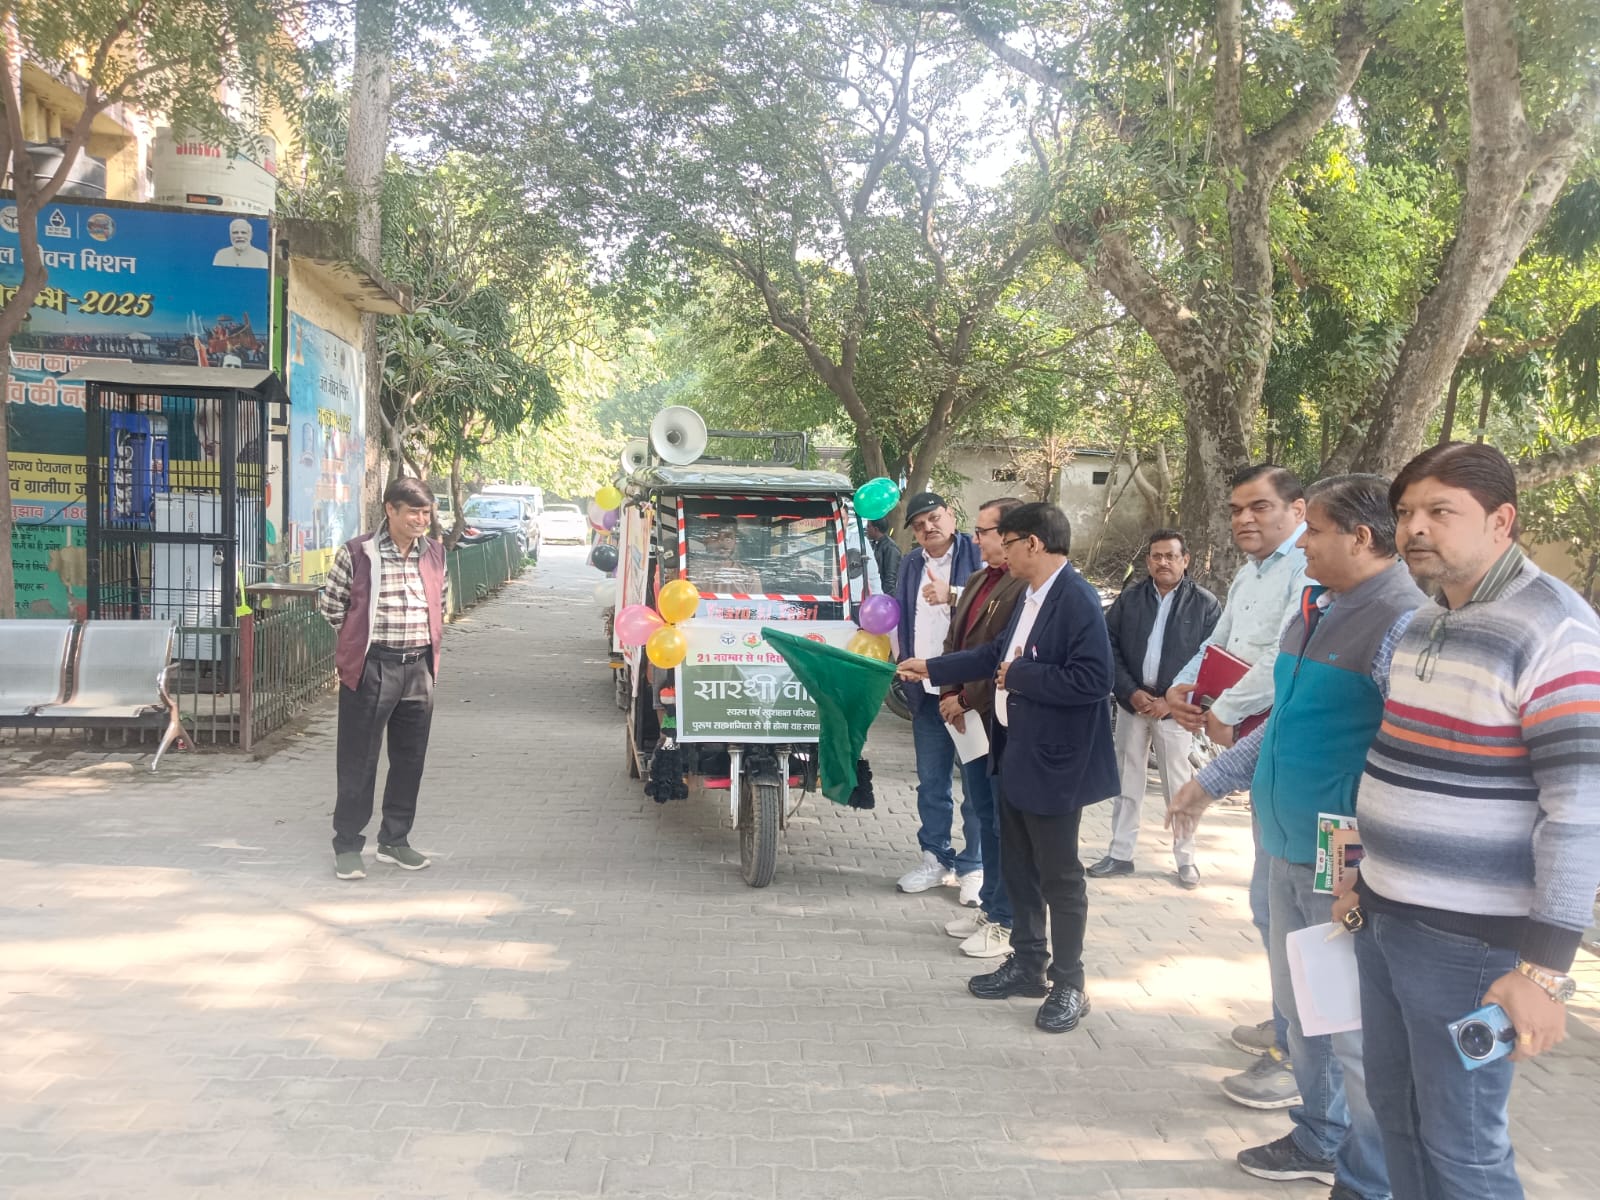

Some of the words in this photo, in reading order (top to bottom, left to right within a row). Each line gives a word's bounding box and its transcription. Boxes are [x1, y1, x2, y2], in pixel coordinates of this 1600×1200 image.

[80, 248, 137, 274] मिशन
[43, 354, 67, 373] का
[28, 377, 58, 406] की
[8, 460, 33, 472] राज्य
[36, 459, 72, 474] पेयजल
[24, 478, 71, 494] ग्रामीण
[697, 653, 710, 663] 21
[713, 653, 743, 662] नवम्बर
[746, 651, 754, 662] से
[693, 673, 778, 701] सारथी
[748, 706, 761, 717] एवं
[762, 709, 791, 719] खुशहाल
[792, 707, 816, 718] परिवार
[713, 720, 752, 729] सहभागिता
[753, 720, 761, 730] से
[763, 720, 771, 730] ही
[773, 721, 789, 730] होगा
